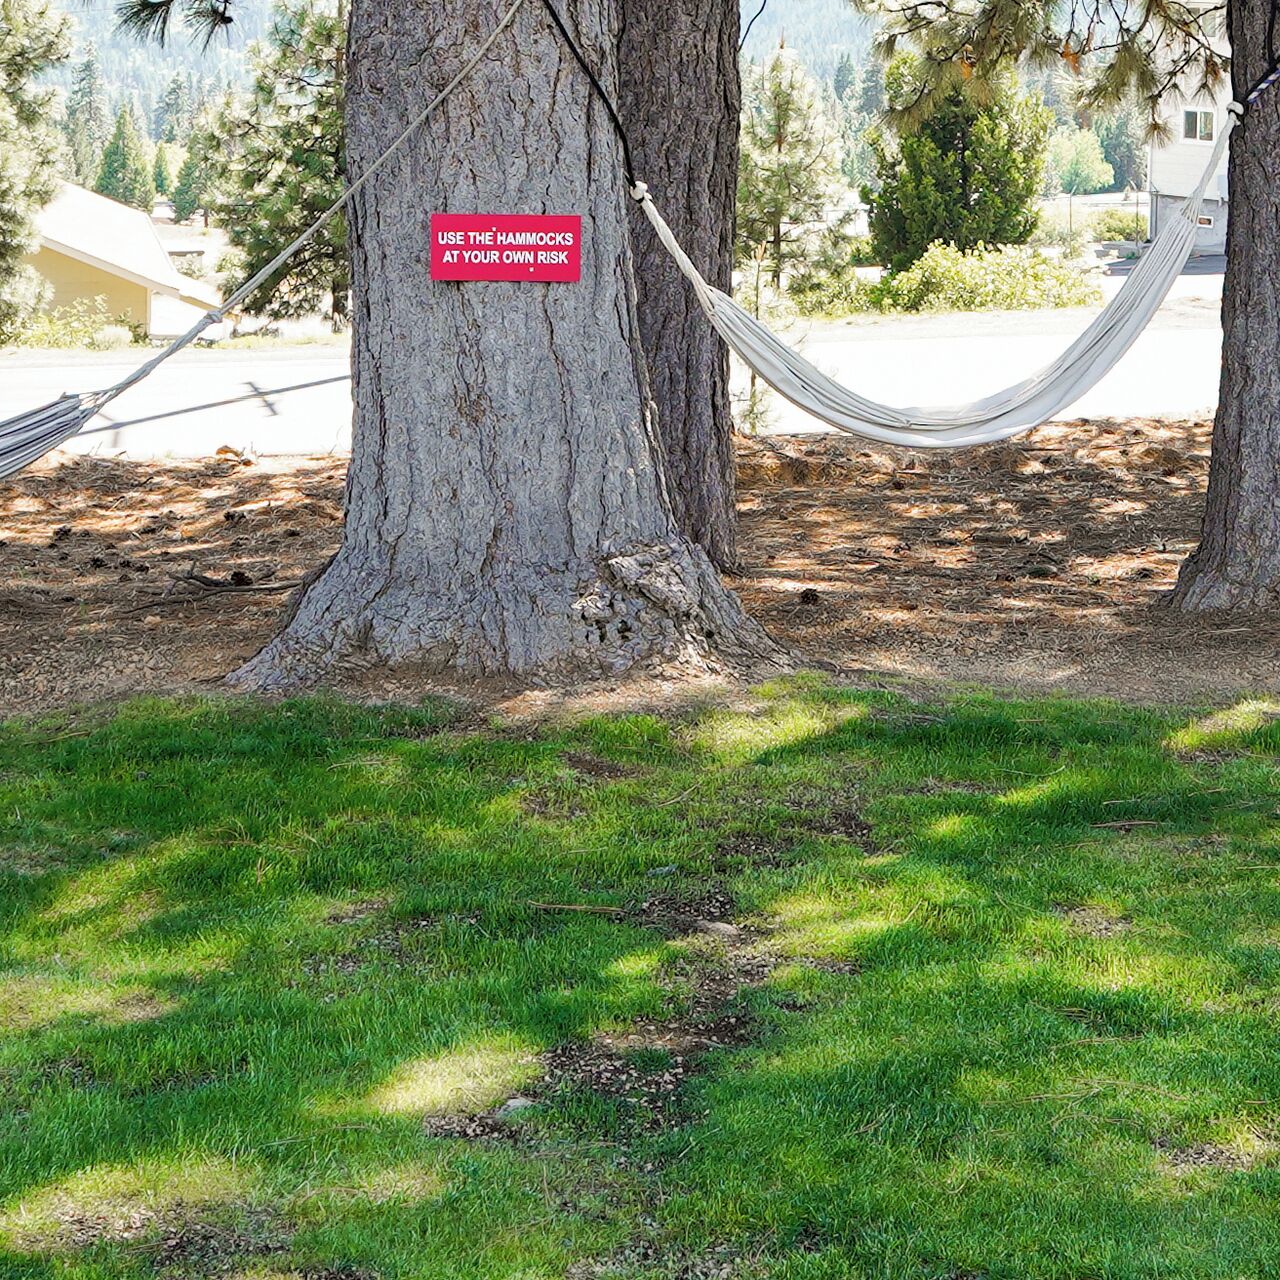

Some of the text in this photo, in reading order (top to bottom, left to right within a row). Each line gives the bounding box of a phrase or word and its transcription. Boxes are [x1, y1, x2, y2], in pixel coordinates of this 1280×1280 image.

[438, 231, 573, 246] USE THE HAMMOCKS
[442, 250, 568, 264] AT YOUR OWN RISK
